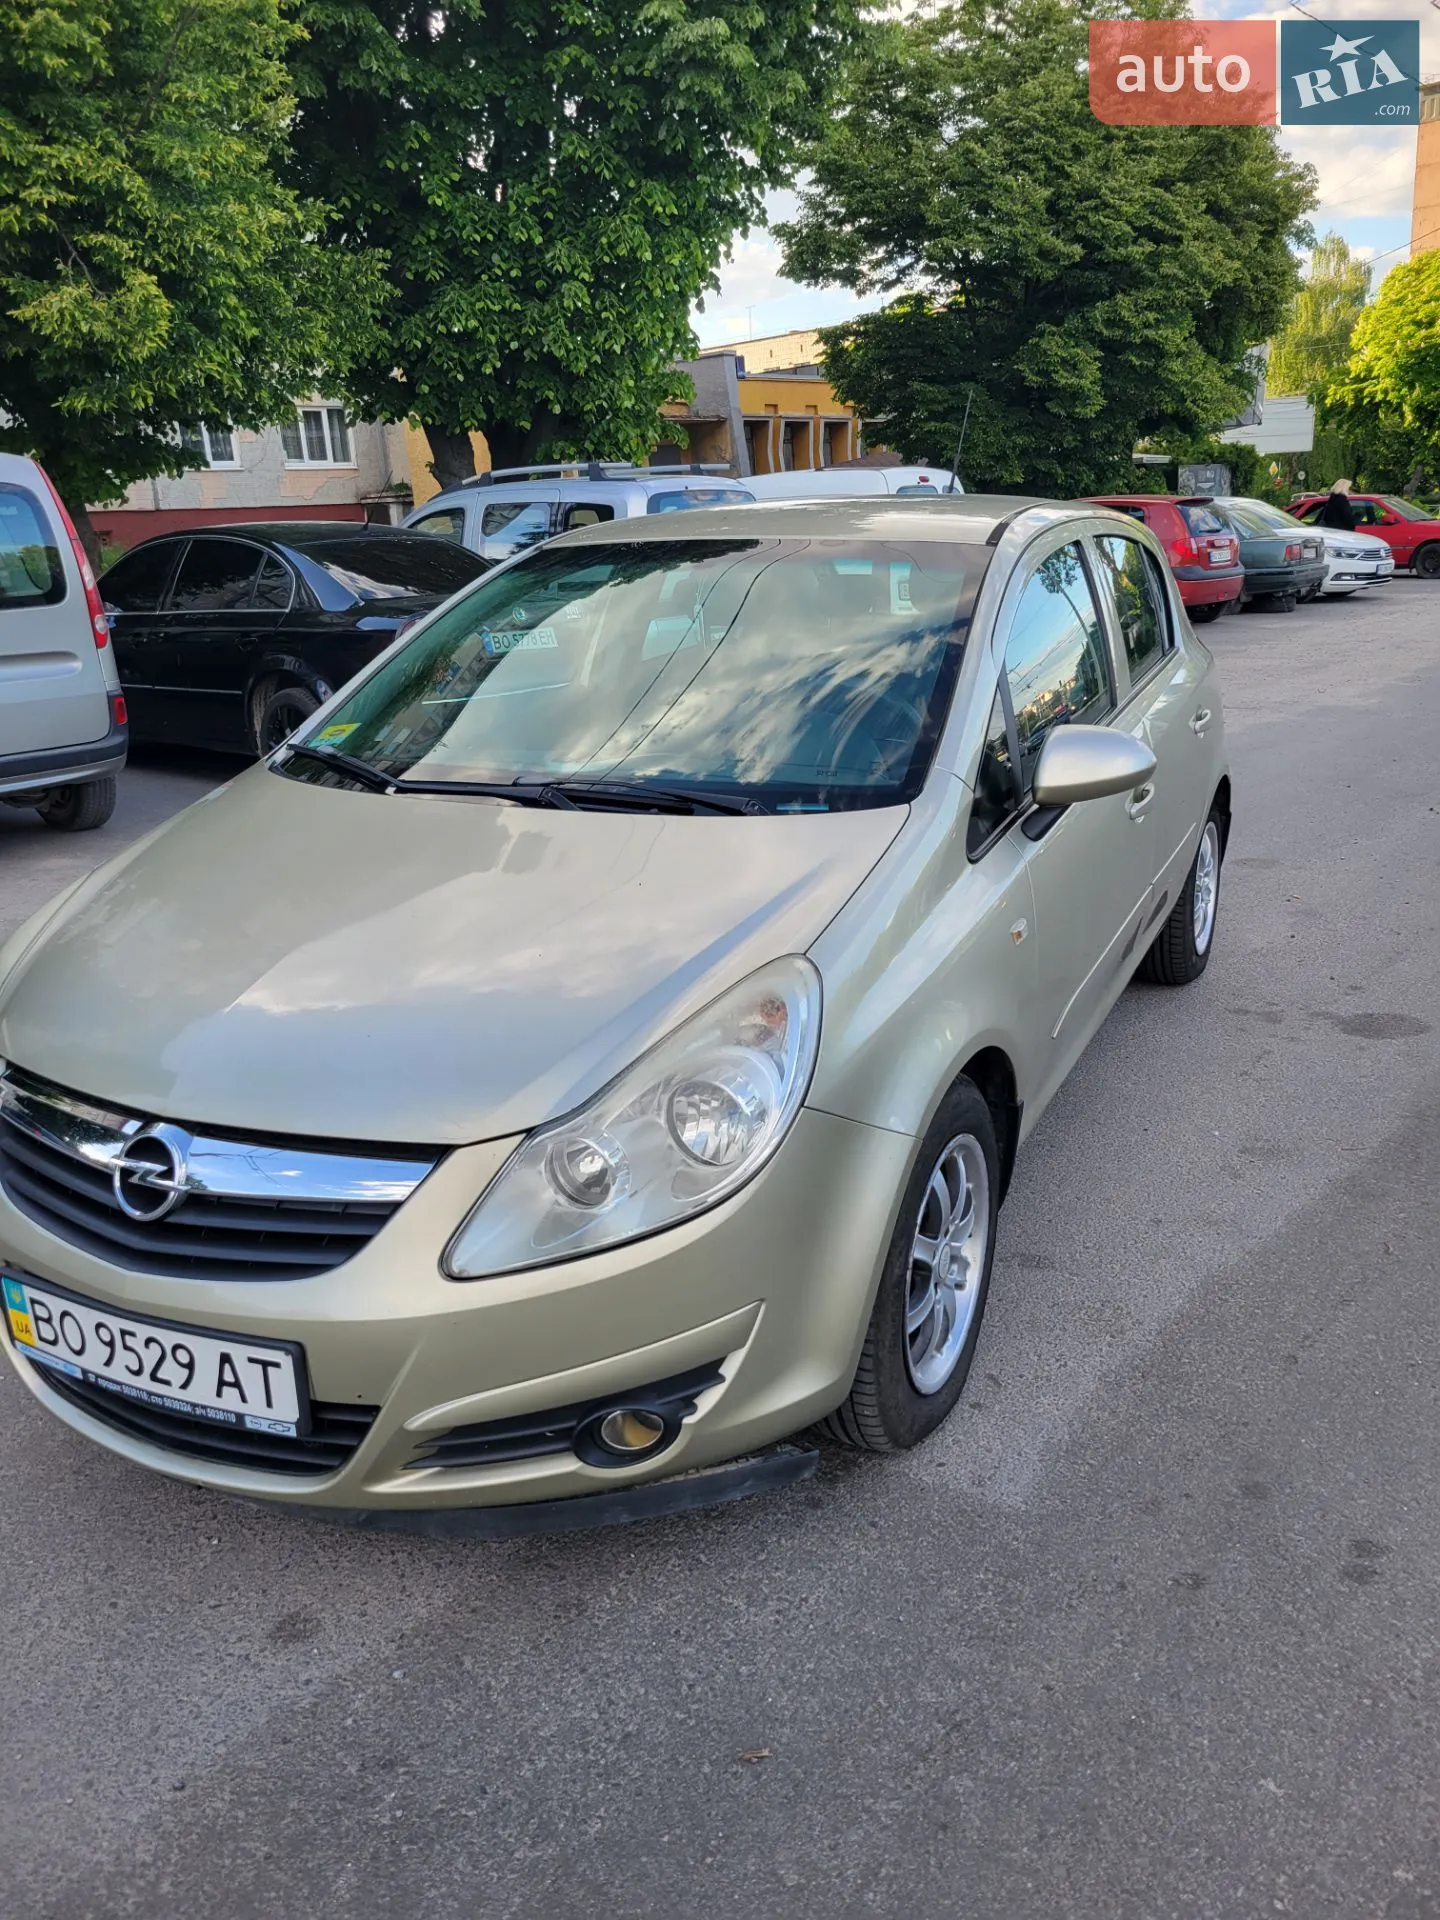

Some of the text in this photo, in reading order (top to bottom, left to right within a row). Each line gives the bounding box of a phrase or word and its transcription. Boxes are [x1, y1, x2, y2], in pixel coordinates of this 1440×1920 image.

[16, 1319, 33, 1337] UA
[29, 1296, 87, 1357] BO
[94, 1321, 196, 1391] 9529
[216, 1351, 282, 1409] AT
